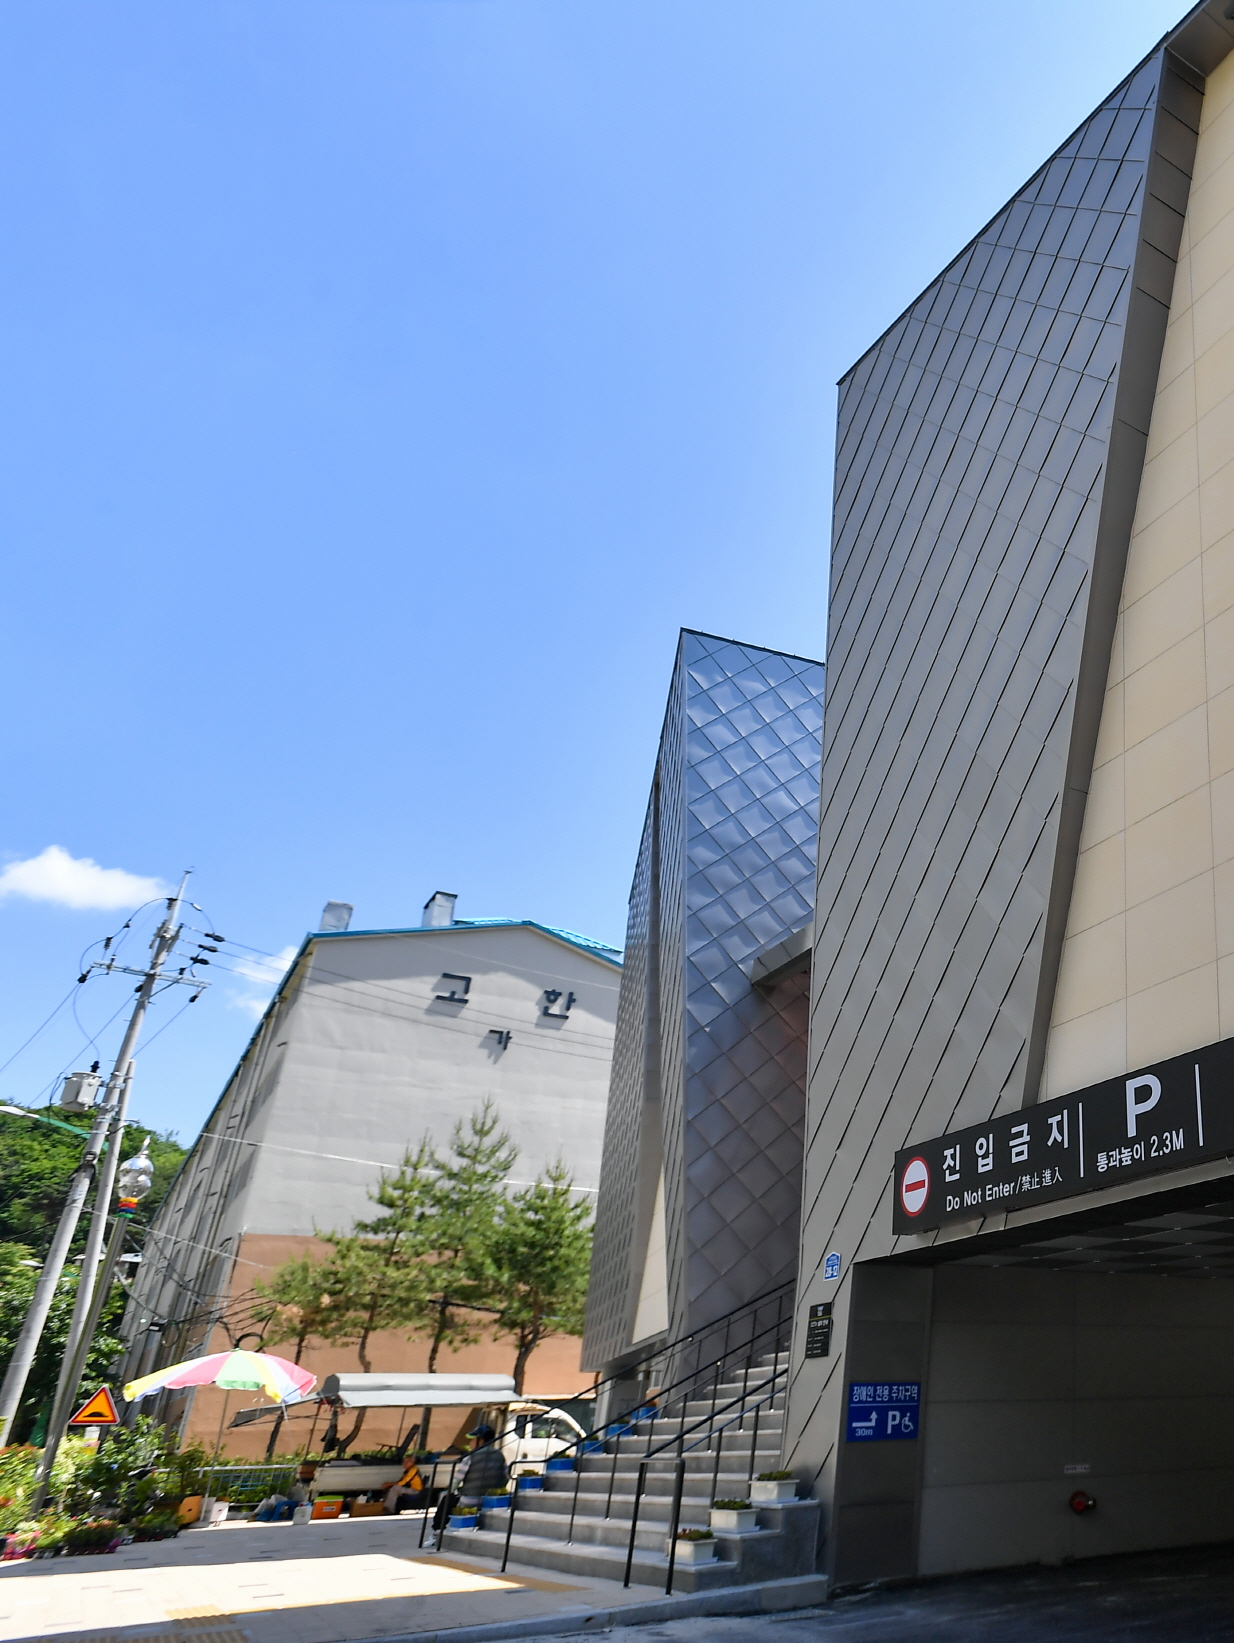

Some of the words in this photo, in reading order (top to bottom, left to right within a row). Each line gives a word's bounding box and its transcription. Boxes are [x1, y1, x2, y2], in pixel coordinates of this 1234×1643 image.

[488, 1029, 513, 1051] 가
[1126, 1074, 1162, 1138] P
[1096, 1140, 1145, 1172] 통과높이
[1150, 1128, 1185, 1158] 2.3M
[946, 1195, 961, 1212] Do
[963, 1187, 982, 1207] Not
[852, 1385, 874, 1402] 장애인
[875, 1385, 890, 1402] 전용
[891, 1385, 919, 1401] 주차구역
[855, 1428, 874, 1437] 30m
[887, 1410, 901, 1435] P
